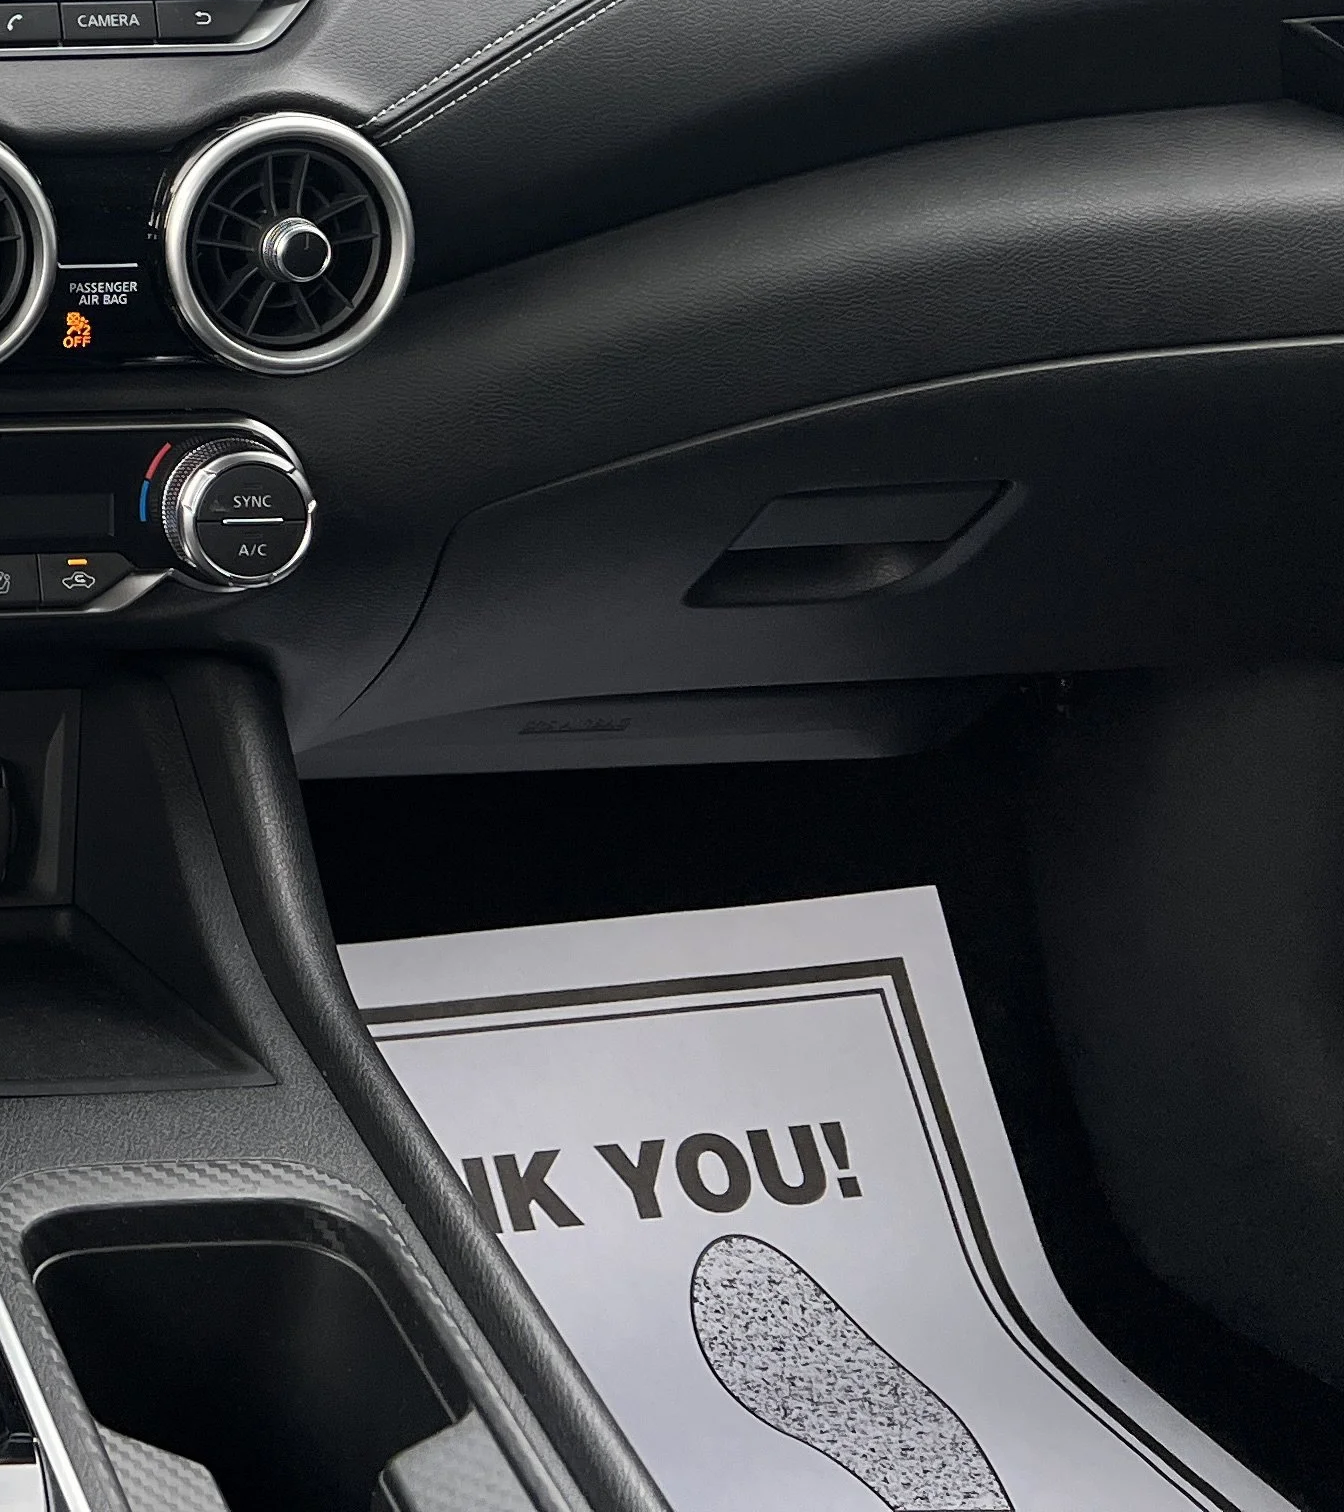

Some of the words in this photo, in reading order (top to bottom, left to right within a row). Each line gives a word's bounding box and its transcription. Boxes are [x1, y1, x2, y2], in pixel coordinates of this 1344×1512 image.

[77, 13, 141, 29] CAMERA
[69, 281, 138, 294] PASSENGER
[78, 294, 99, 306] AIR
[102, 293, 128, 305] BAG
[62, 335, 92, 349] OFF
[233, 494, 272, 508] SYNC
[238, 543, 268, 557] A/C
[593, 1121, 863, 1220] YOU!
